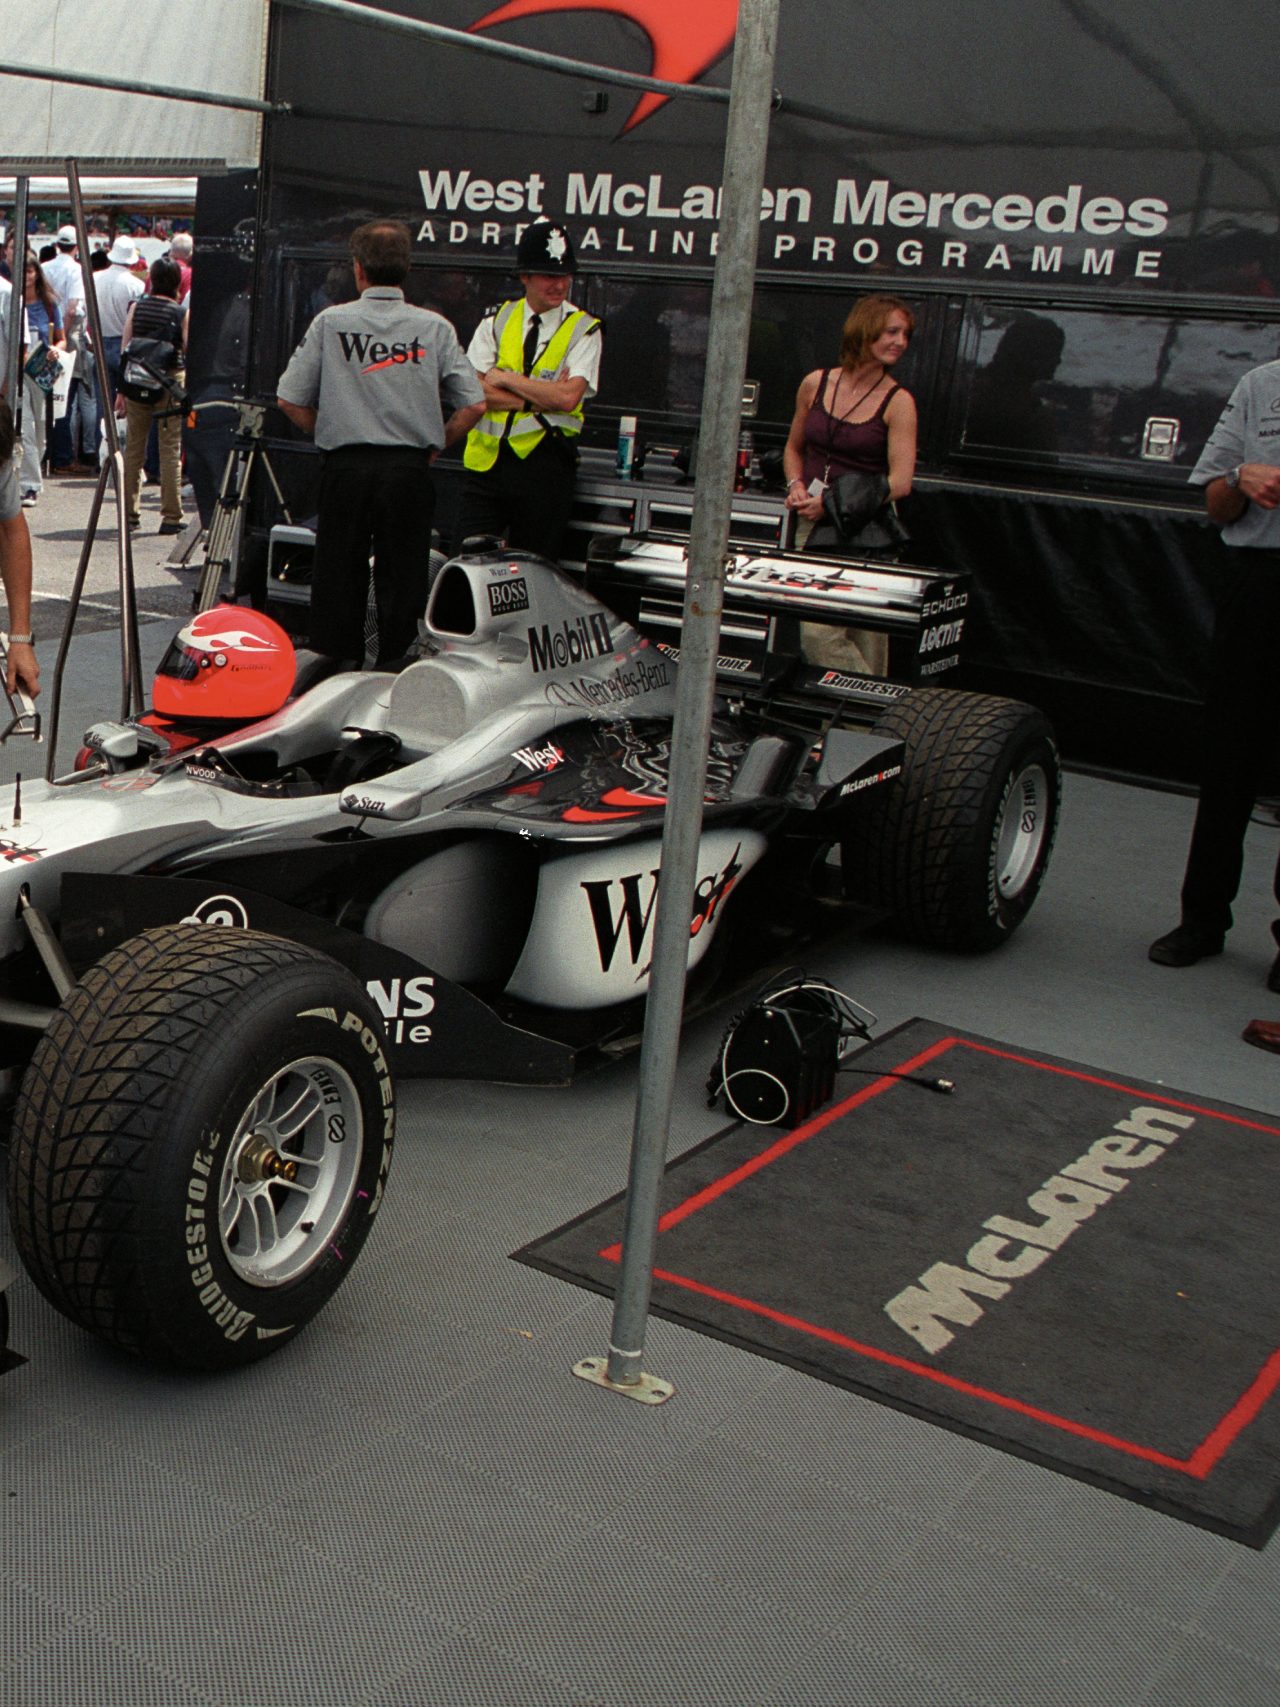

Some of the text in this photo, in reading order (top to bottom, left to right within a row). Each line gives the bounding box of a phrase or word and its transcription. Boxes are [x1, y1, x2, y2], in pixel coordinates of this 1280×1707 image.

[419, 170, 1168, 237] West McLaen Mercedes
[774, 235, 1162, 278] PROGRAMME
[337, 331, 424, 365] West
[490, 581, 527, 606] BOSS
[528, 617, 595, 673] Mobil
[570, 660, 671, 708] Mercedes-Benz
[818, 671, 911, 698] BRIDGESTO
[186, 765, 216, 779] NWOOD
[511, 741, 563, 771] West
[357, 795, 386, 812] Sun
[580, 841, 743, 973] Wst
[340, 1010, 395, 1216] POTENZA
[883, 1104, 1196, 1354] McLaren
